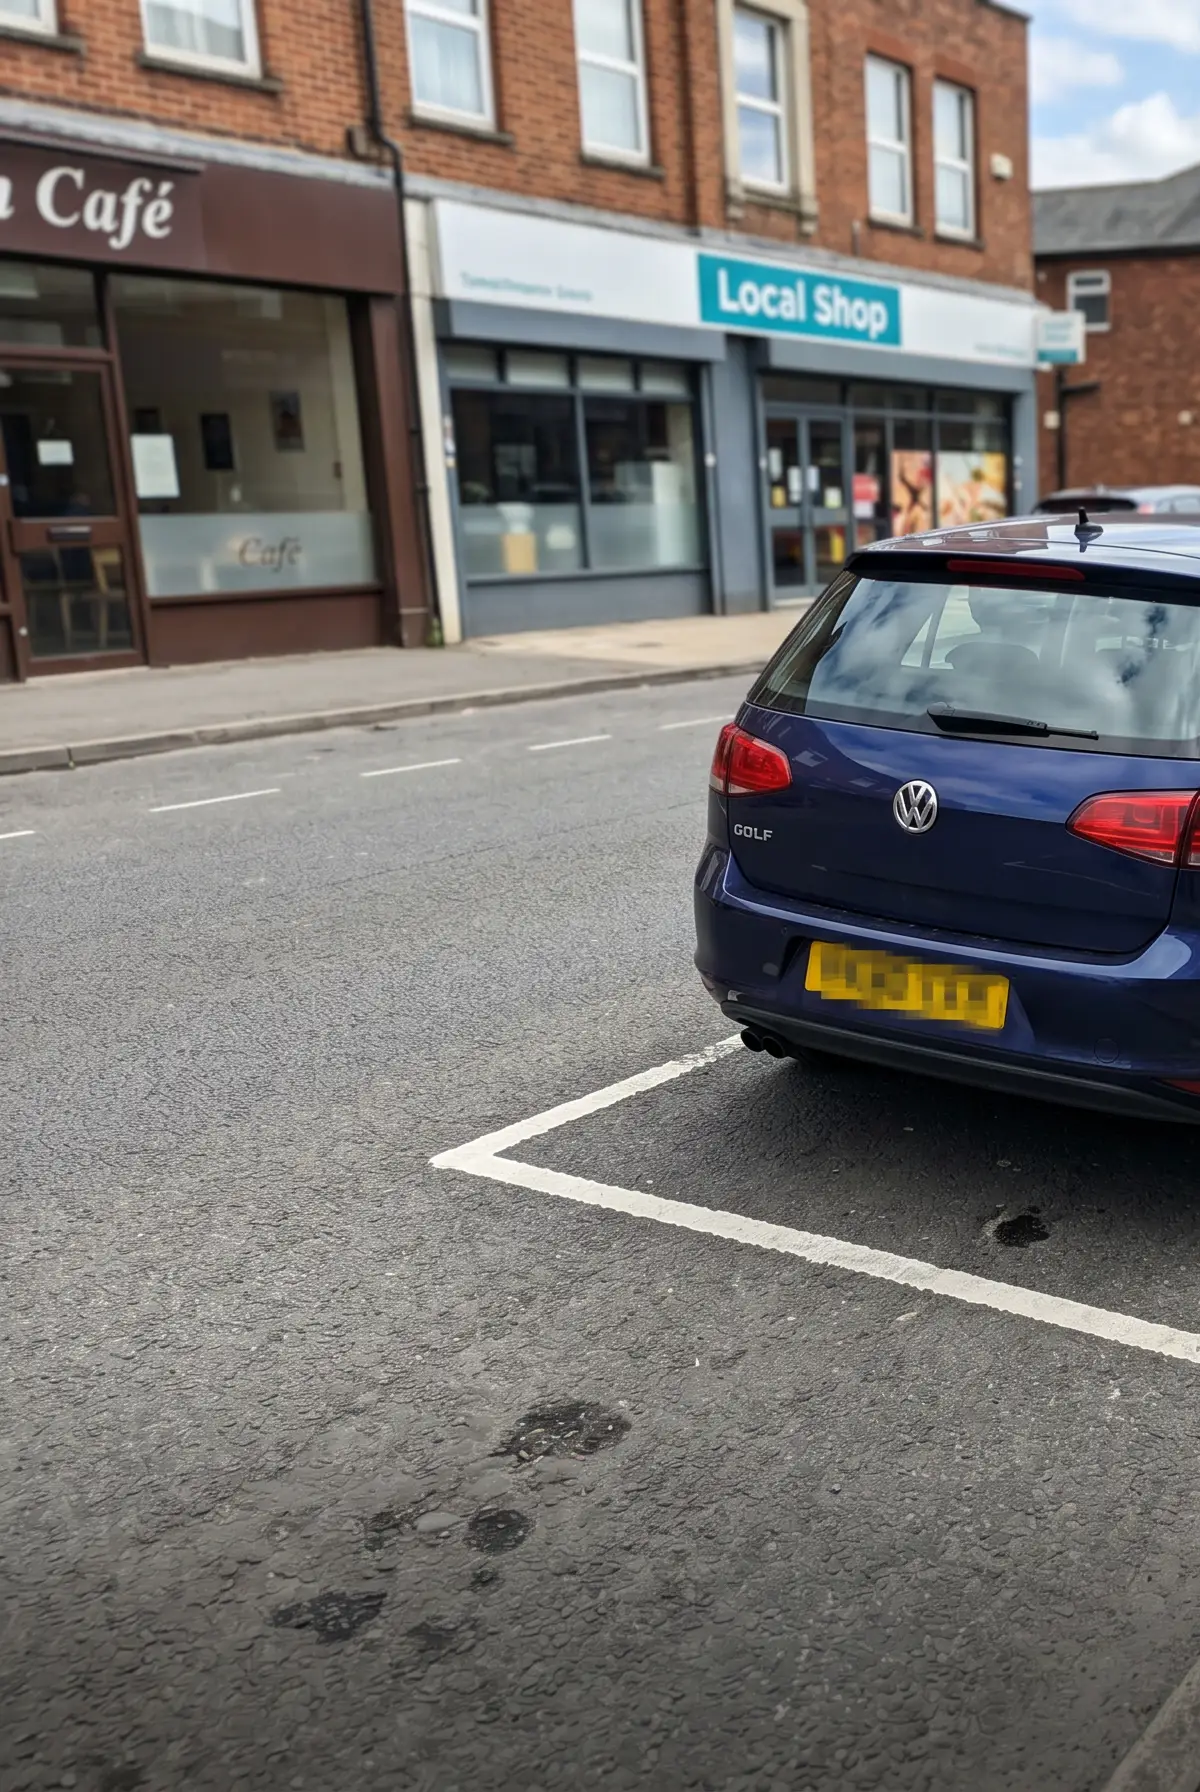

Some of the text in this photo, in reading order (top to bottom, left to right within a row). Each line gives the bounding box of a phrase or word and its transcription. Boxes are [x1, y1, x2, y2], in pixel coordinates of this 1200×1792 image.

[36, 166, 174, 249] Café
[717, 267, 888, 340] Local Shop
[734, 823, 773, 841] GOLF
